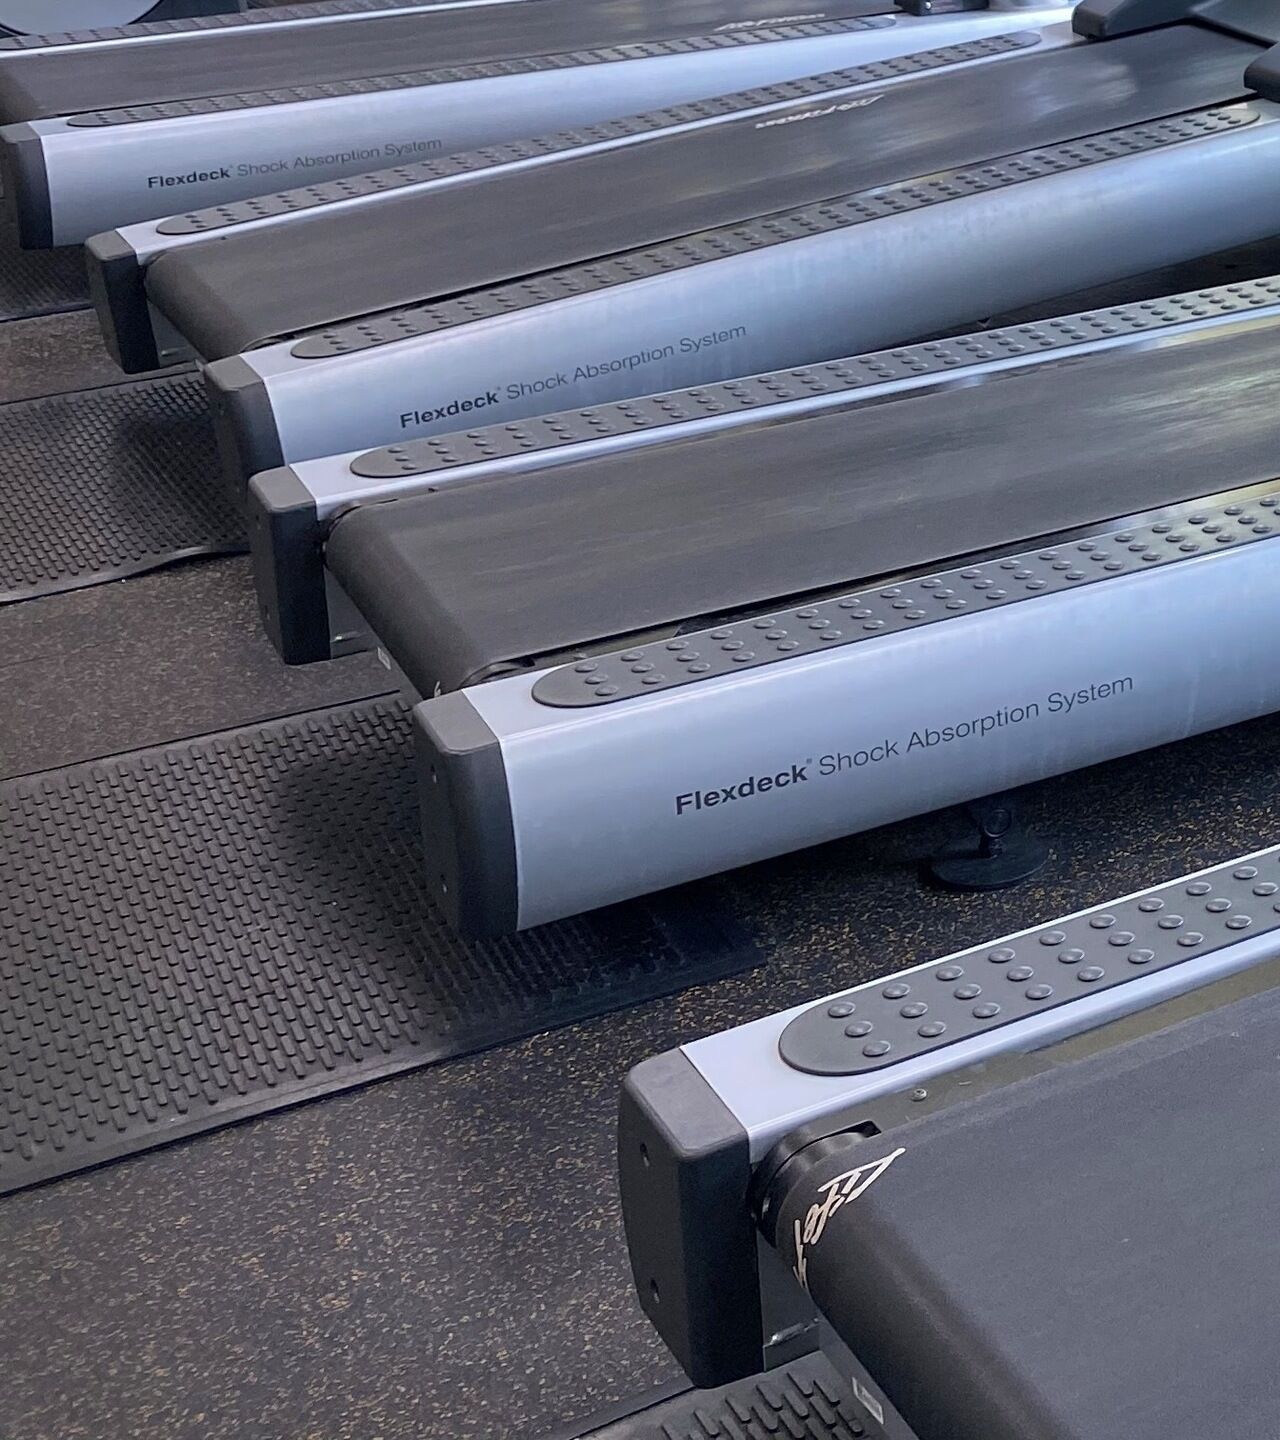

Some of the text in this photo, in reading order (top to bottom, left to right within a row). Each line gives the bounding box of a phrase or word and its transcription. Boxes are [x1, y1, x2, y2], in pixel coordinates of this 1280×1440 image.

[147, 137, 443, 189] Flexdeck Shock Absorption System
[399, 324, 747, 429] Flexdeck Shock Absorption System
[674, 673, 1136, 816] Flexdeck Shock Absorption System
